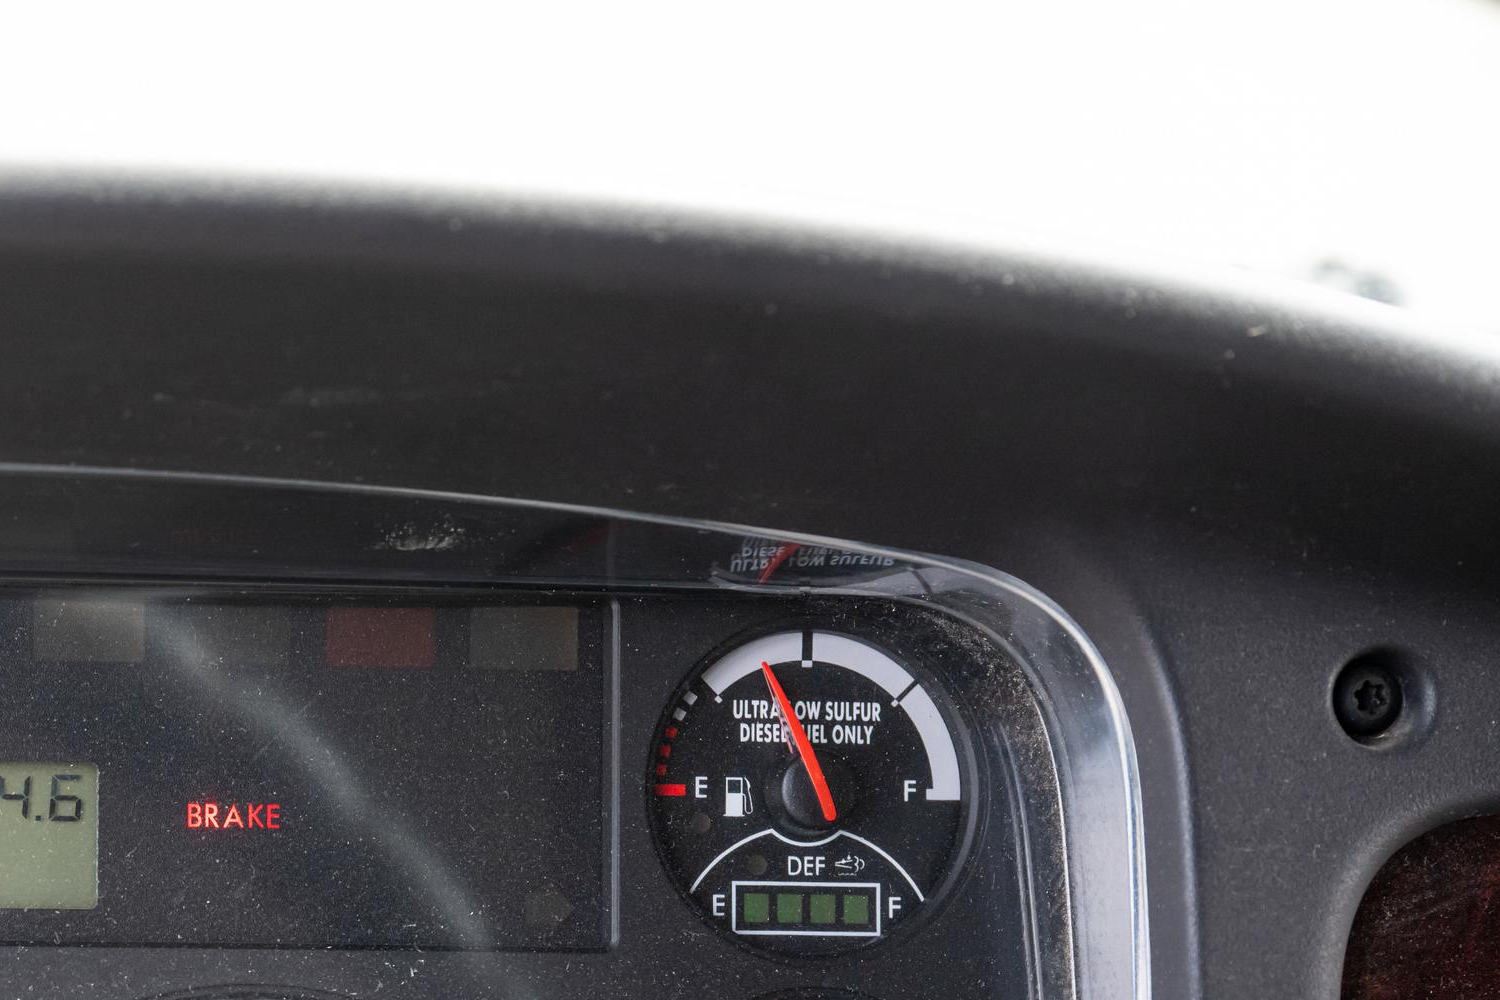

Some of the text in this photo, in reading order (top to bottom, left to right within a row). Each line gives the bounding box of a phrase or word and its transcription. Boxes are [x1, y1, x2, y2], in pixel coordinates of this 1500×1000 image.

[787, 700, 821, 720] OW
[825, 701, 881, 722] SULFUR
[832, 725, 874, 745] ONLY
[694, 775, 708, 799] E
[903, 779, 917, 802] F
[187, 802, 280, 829] BRAKE
[787, 855, 826, 877] DEF
[712, 893, 726, 917] E
[888, 896, 902, 919] F
